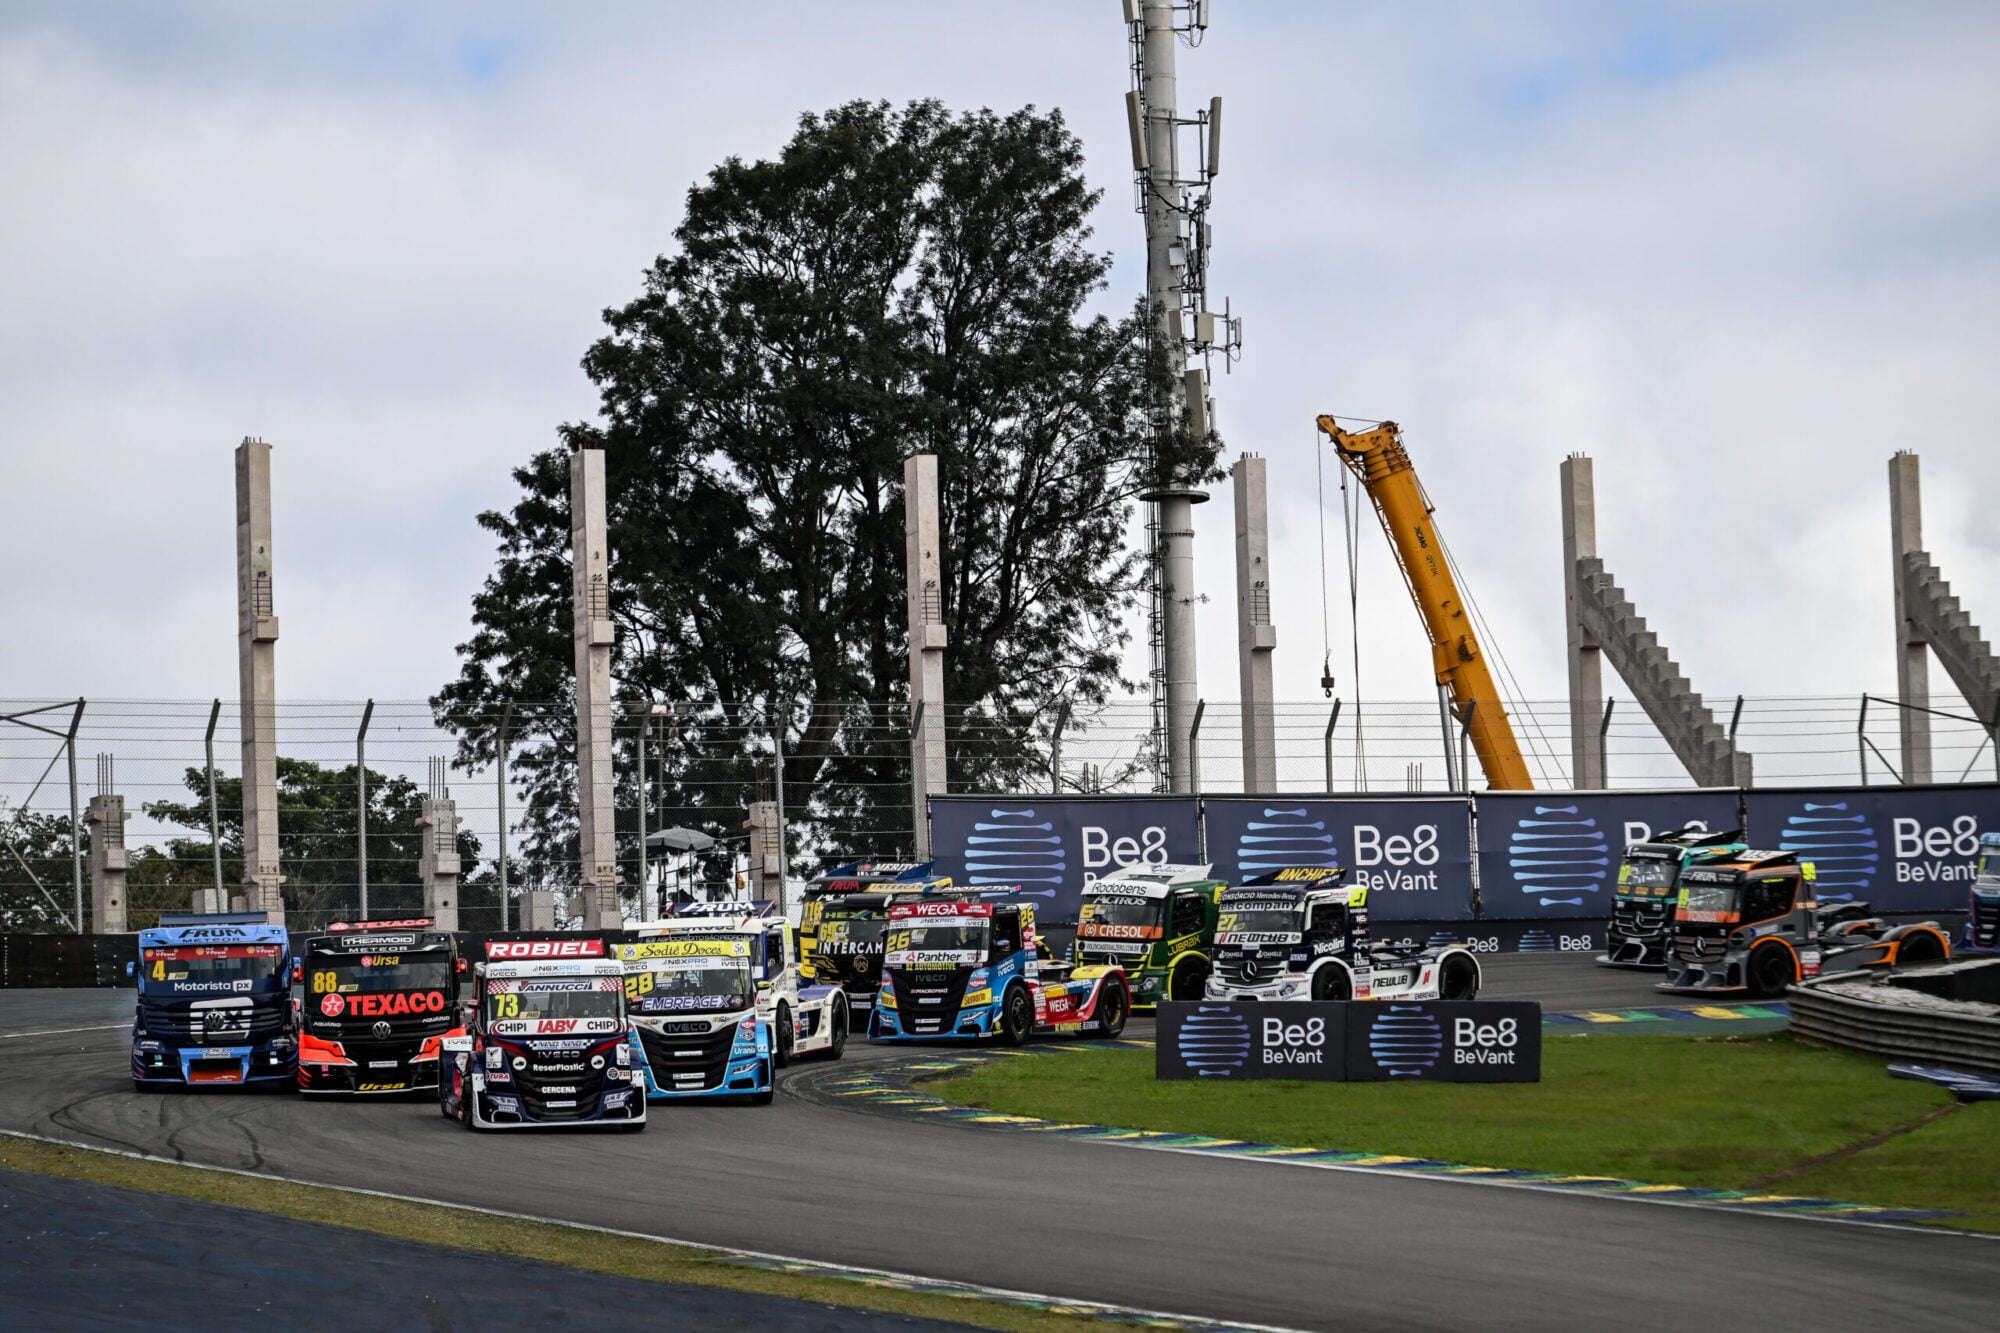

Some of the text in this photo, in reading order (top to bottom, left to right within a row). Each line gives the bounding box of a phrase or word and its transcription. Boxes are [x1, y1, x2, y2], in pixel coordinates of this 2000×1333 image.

[1414, 526, 1428, 549] XCMG
[1893, 816, 1979, 857] Be8
[1354, 825, 1440, 866] Be8
[1896, 861, 1978, 882] BeVant
[1355, 870, 1438, 891] BeVant
[1091, 882, 1147, 896] Rodobens
[680, 901, 756, 912] FRUM
[1093, 895, 1148, 905] ACTROS
[917, 904, 959, 916] WEGA
[1020, 905, 1034, 929] 26
[354, 918, 430, 929] TEXACO
[178, 928, 247, 938] FRUM
[1100, 925, 1144, 938] CRESOL
[344, 937, 413, 945] THERMOID
[818, 941, 884, 955] INTERCAM
[886, 931, 910, 954] 26
[1313, 937, 1345, 955] Nicolini
[1560, 935, 1591, 951] Be8
[489, 942, 598, 956] ROBIEL
[681, 942, 722, 956] Doces
[372, 955, 399, 966] Ursa
[917, 952, 961, 962] Panther
[152, 960, 166, 981] 4
[998, 964, 1014, 976] IVECO
[174, 981, 250, 993] Motorista px
[313, 972, 337, 993] 88
[518, 980, 592, 992] VANNUCCI
[625, 972, 654, 999] 28
[346, 991, 445, 1016] TEXACO
[495, 994, 519, 1018] 73
[642, 995, 731, 1011] EMBREAGEX
[1049, 998, 1069, 1013] WEGA
[497, 1023, 527, 1032] CHIPI
[587, 1021, 616, 1030] CHIPI
[668, 1022, 708, 1032] IVECO
[1263, 1017, 1325, 1046] Be8
[1455, 1017, 1517, 1046] Be8
[1263, 1048, 1323, 1064] BeVant
[1454, 1048, 1515, 1064] BeVant
[533, 1062, 585, 1072] ReserPlastic
[358, 1082, 406, 1092] Ursa
